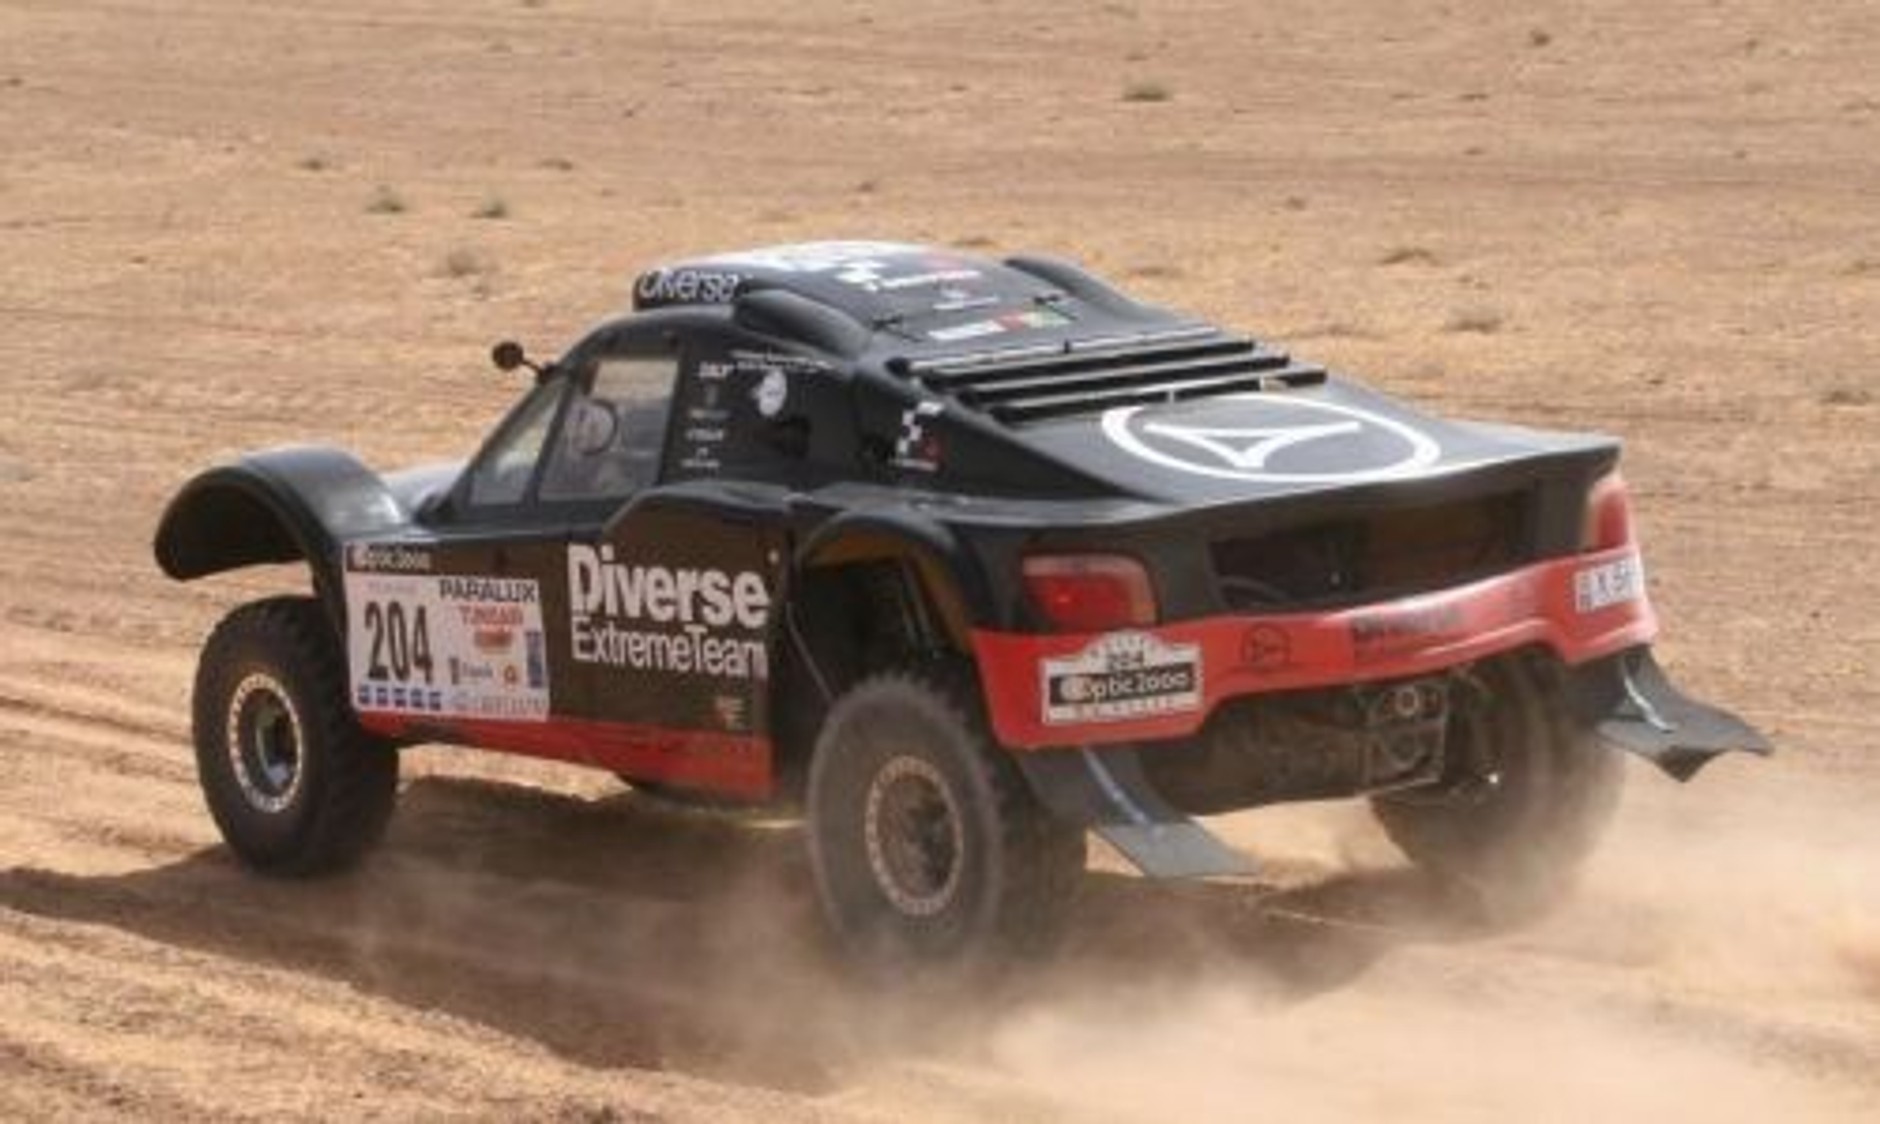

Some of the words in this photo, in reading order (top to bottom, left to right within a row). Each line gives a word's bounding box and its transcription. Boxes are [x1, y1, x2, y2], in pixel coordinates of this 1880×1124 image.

[439, 579, 537, 602] PARALUX
[567, 543, 771, 629] Diverse
[364, 601, 434, 686] 204
[570, 615, 769, 681] ExtremeTeam
